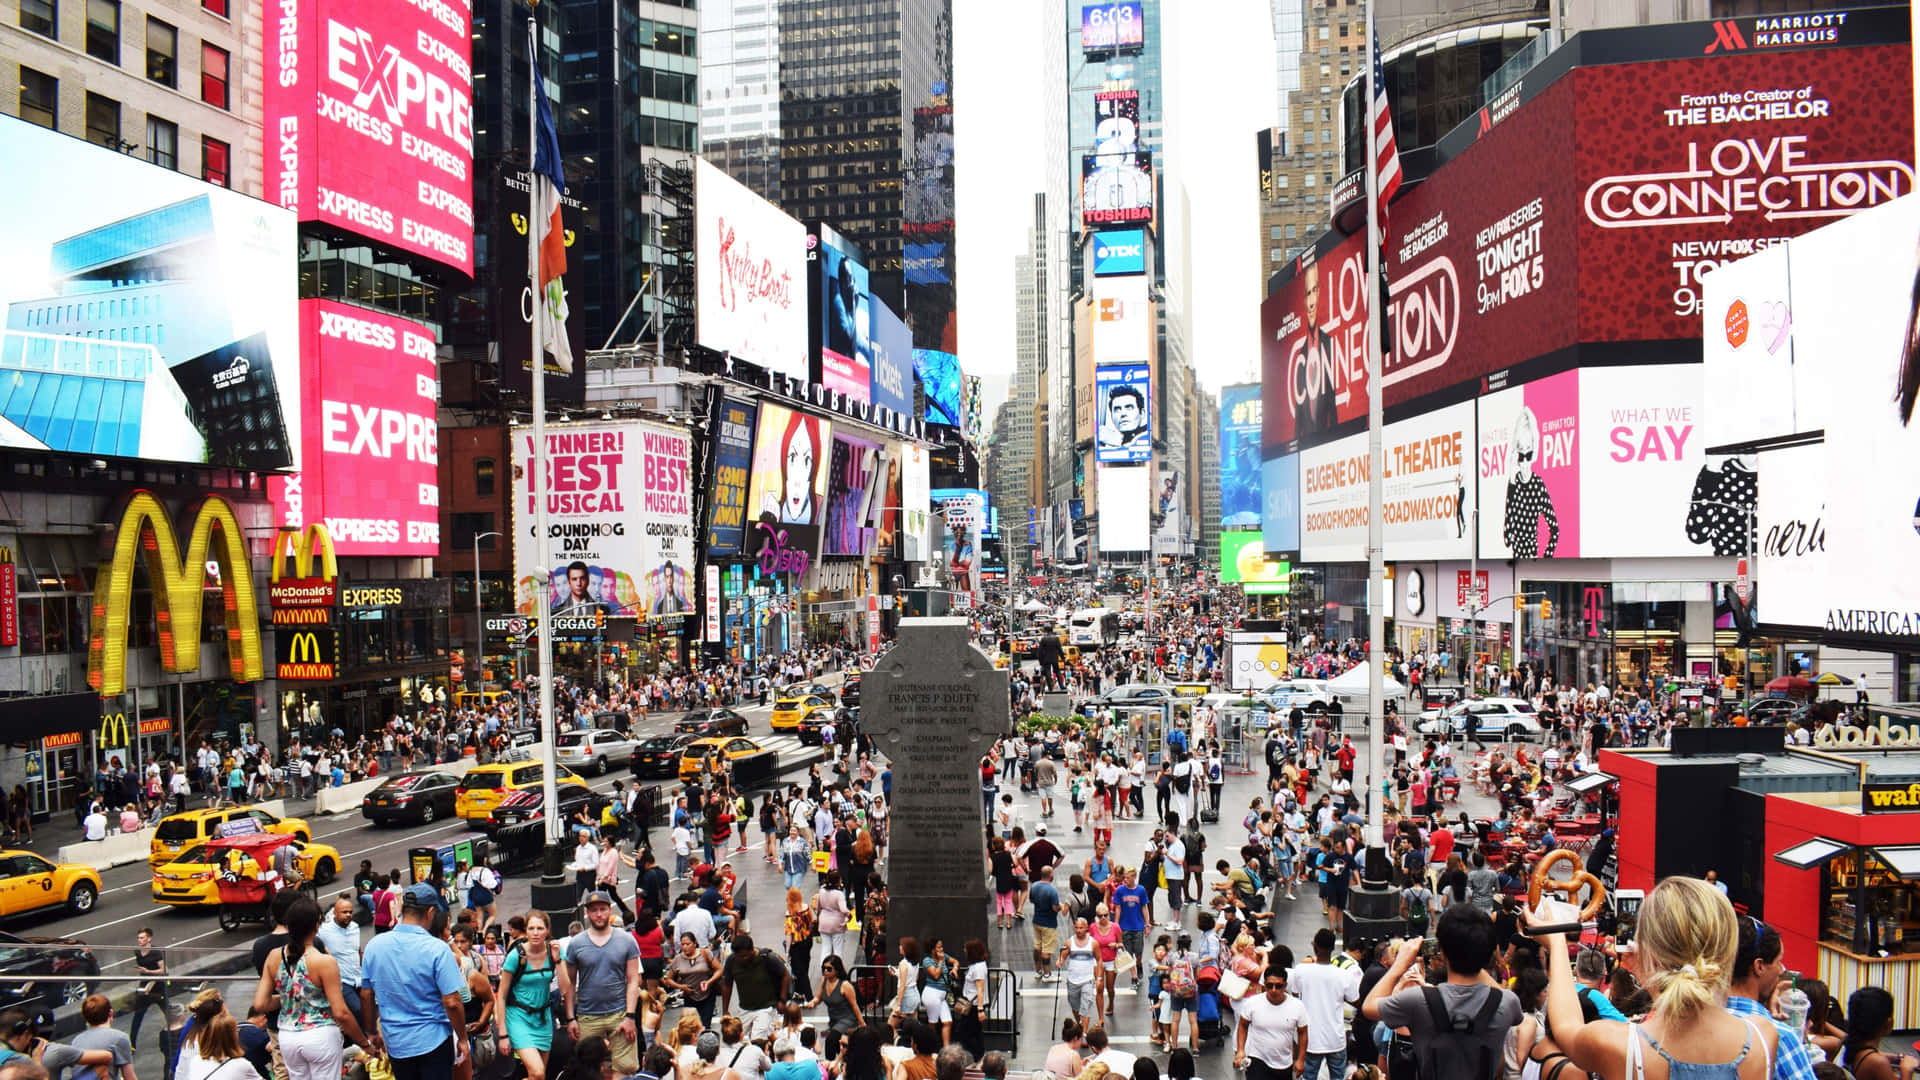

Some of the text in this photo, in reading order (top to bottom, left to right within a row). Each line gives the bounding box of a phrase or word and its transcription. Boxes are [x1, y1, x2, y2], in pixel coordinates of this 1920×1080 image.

[1090, 8, 1133, 25] 6:03
[1756, 13, 1848, 31] MARRIOTT
[1756, 29, 1836, 46] MARQUIS
[417, 29, 472, 87] EXPRESS
[328, 18, 474, 155] EXPRE
[1095, 91, 1139, 101] TOSHIBA
[1492, 80, 1523, 111] MARRIOTT
[1681, 86, 1813, 107] From the Creator of
[1664, 100, 1829, 126] THE BACHELOR
[279, 116, 298, 211] EXPRE
[401, 130, 467, 181] EXPRESS
[1688, 136, 1808, 178] LOVE
[1600, 169, 1900, 219] CONNECTION
[1085, 207, 1152, 222] TOSHIBA
[1476, 197, 1543, 250] NEW FOX SERIES
[402, 217, 467, 262] EXPRESS
[1107, 245, 1140, 257] TDK
[1399, 221, 1449, 265] THE BACHELOR
[1476, 220, 1543, 281] TONIGHT
[1672, 240, 1720, 257] NEW
[1720, 238, 1755, 254] FOX
[1320, 251, 1369, 333] LOV
[1477, 254, 1544, 314] 9PM FOX 5
[767, 367, 926, 440] 1540 BROADWAY
[1611, 407, 1691, 423] WHAT WE
[1562, 416, 1575, 428] YOU
[643, 431, 688, 458] WINNER!
[1543, 429, 1576, 470] PAY
[1609, 425, 1693, 463] SAY
[1306, 464, 1346, 494] EUGENE
[1394, 431, 1462, 475] THEATRE
[1481, 443, 1509, 478] SAY
[644, 454, 688, 494] BEST
[716, 465, 747, 488] COME
[644, 491, 689, 515] MUSICAL
[712, 505, 744, 527] AWAY
[646, 522, 689, 537] GROUNDHOG
[563, 538, 590, 551] DAY
[570, 552, 601, 560] MUSICAL
[661, 537, 674, 551] DAY
[271, 586, 333, 598] McDonald's
[342, 588, 402, 607] EXPRESS
[486, 619, 528, 631] GIFS
[551, 618, 608, 630] UGGAG
[888, 693, 930, 704] FRANCIS
[943, 693, 980, 704] DUFFY
